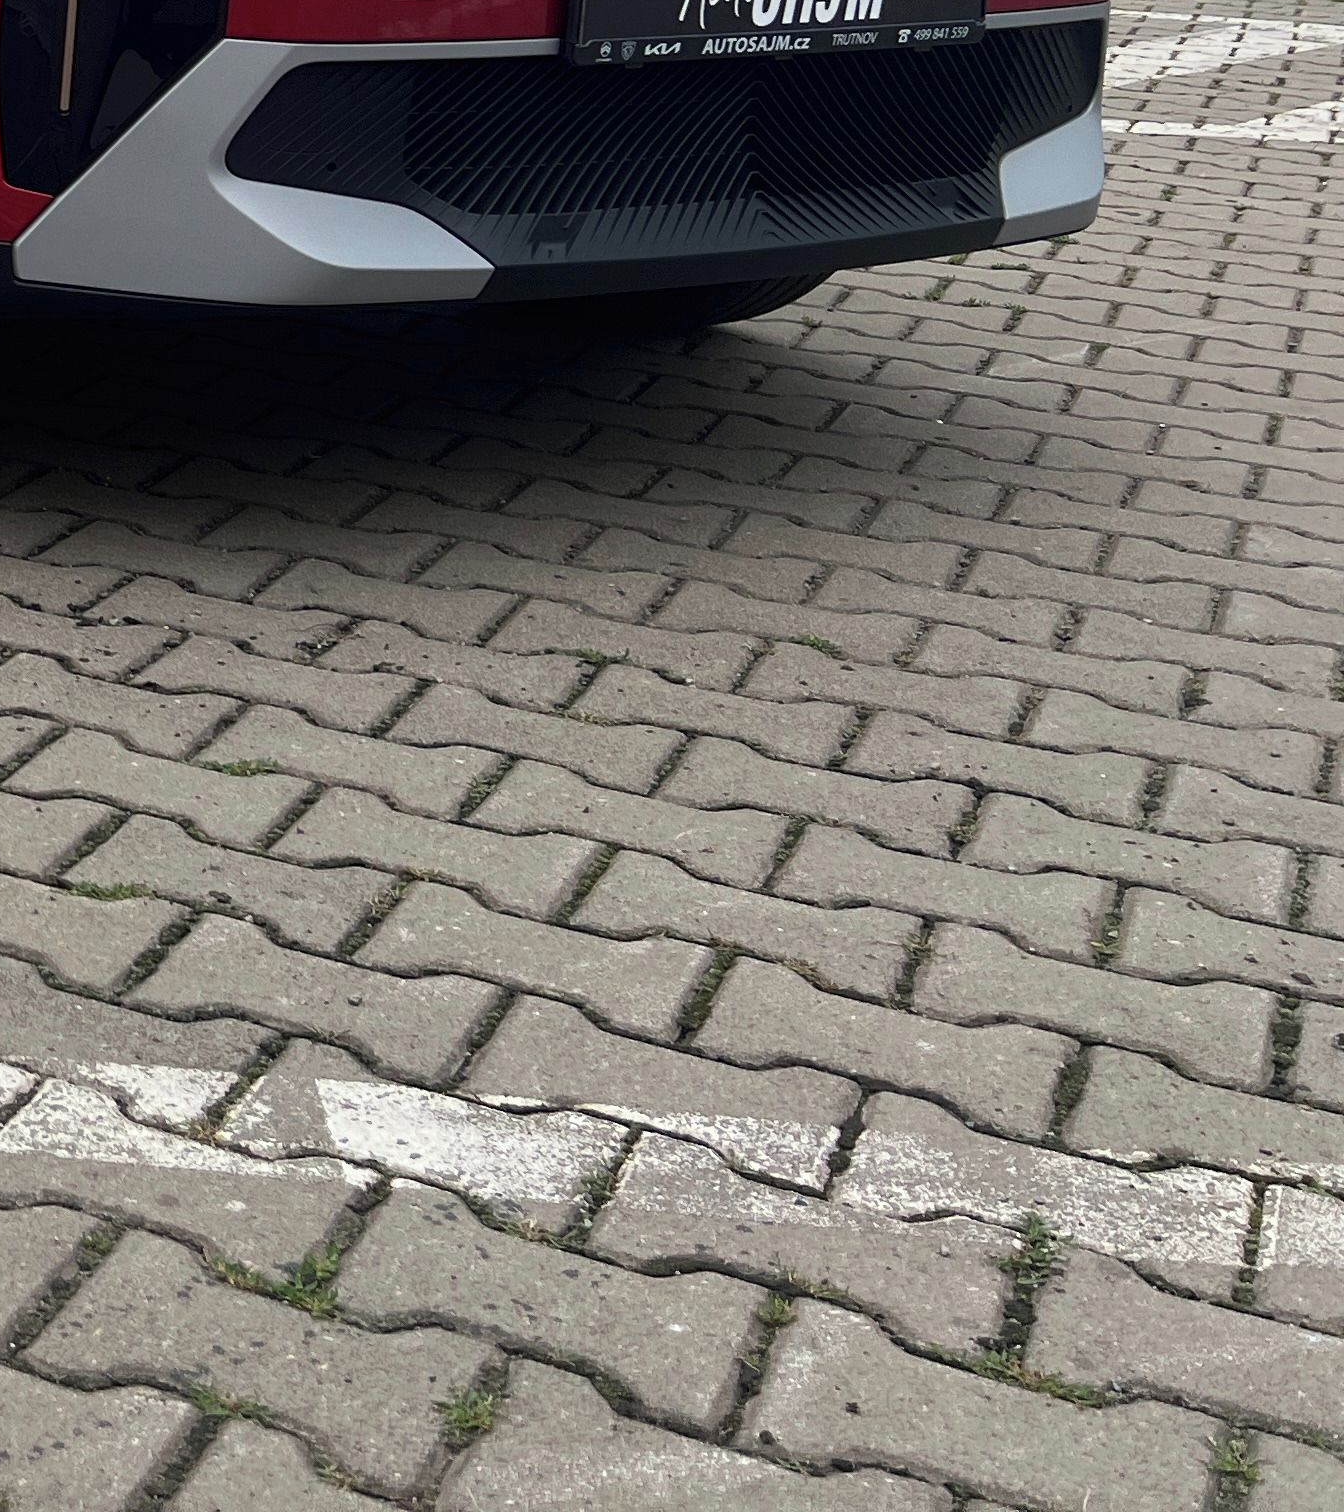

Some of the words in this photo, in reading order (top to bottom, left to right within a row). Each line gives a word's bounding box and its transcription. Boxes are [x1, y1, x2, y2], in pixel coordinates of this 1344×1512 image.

[702, 35, 810, 55] AUTOSAJM.cz
[832, 31, 879, 46] TRUTNOV
[914, 28, 932, 40] 499
[932, 27, 950, 40] 841
